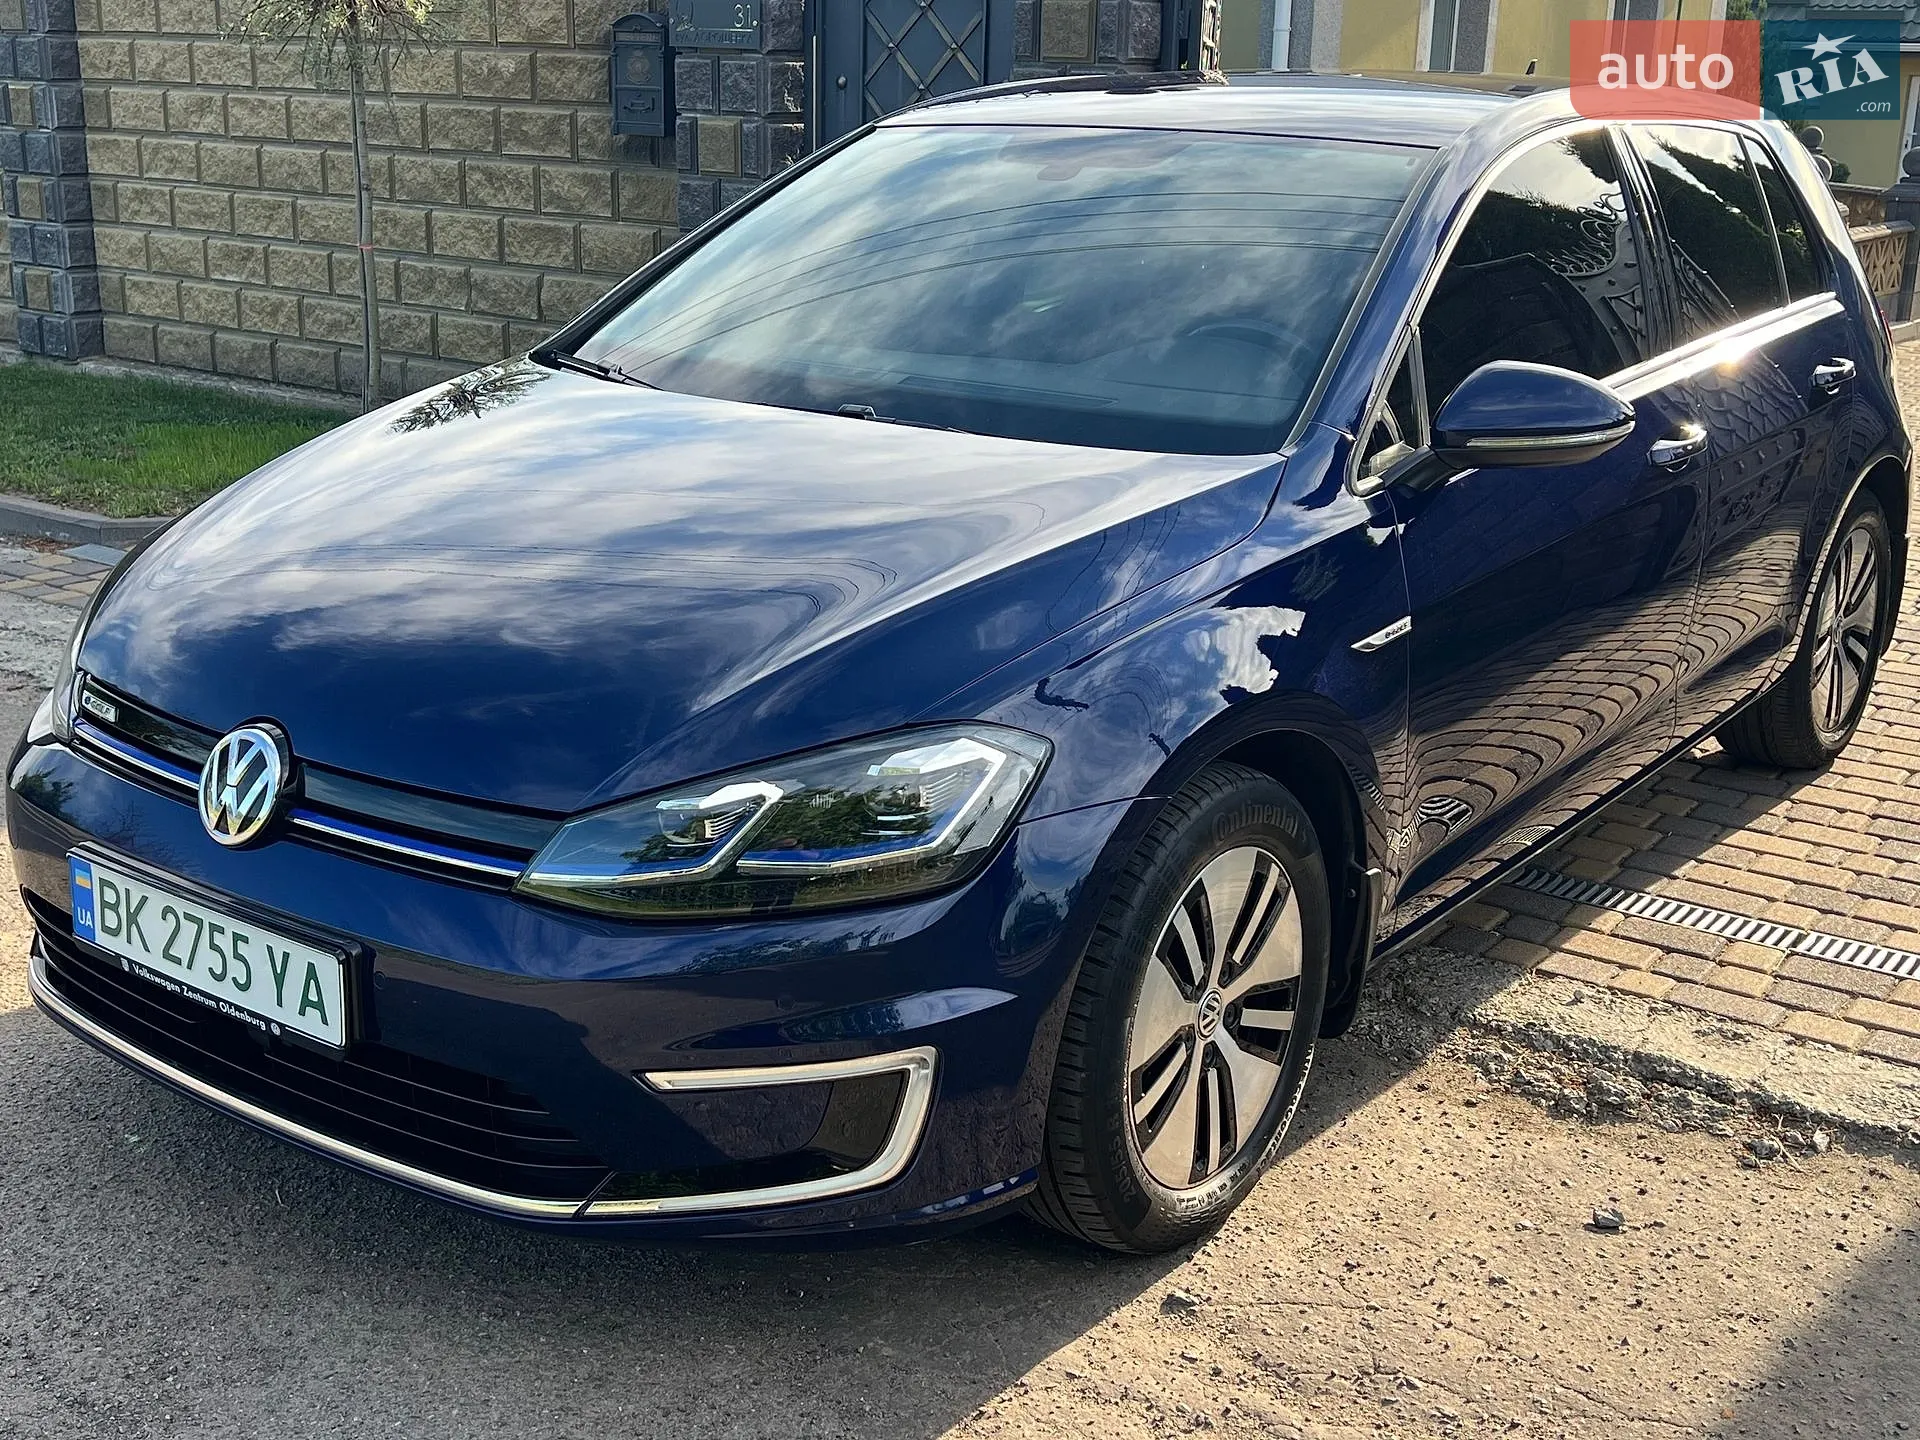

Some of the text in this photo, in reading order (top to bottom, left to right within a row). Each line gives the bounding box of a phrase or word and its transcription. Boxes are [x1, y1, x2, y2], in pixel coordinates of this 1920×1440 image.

[734, 4, 751, 28] 31
[1212, 801, 1299, 846] Continental
[77, 906, 94, 929] UA
[98, 876, 329, 1027] BK 2755 YA
[132, 963, 267, 1031] Volkswagen Zentrum Oldenburg
